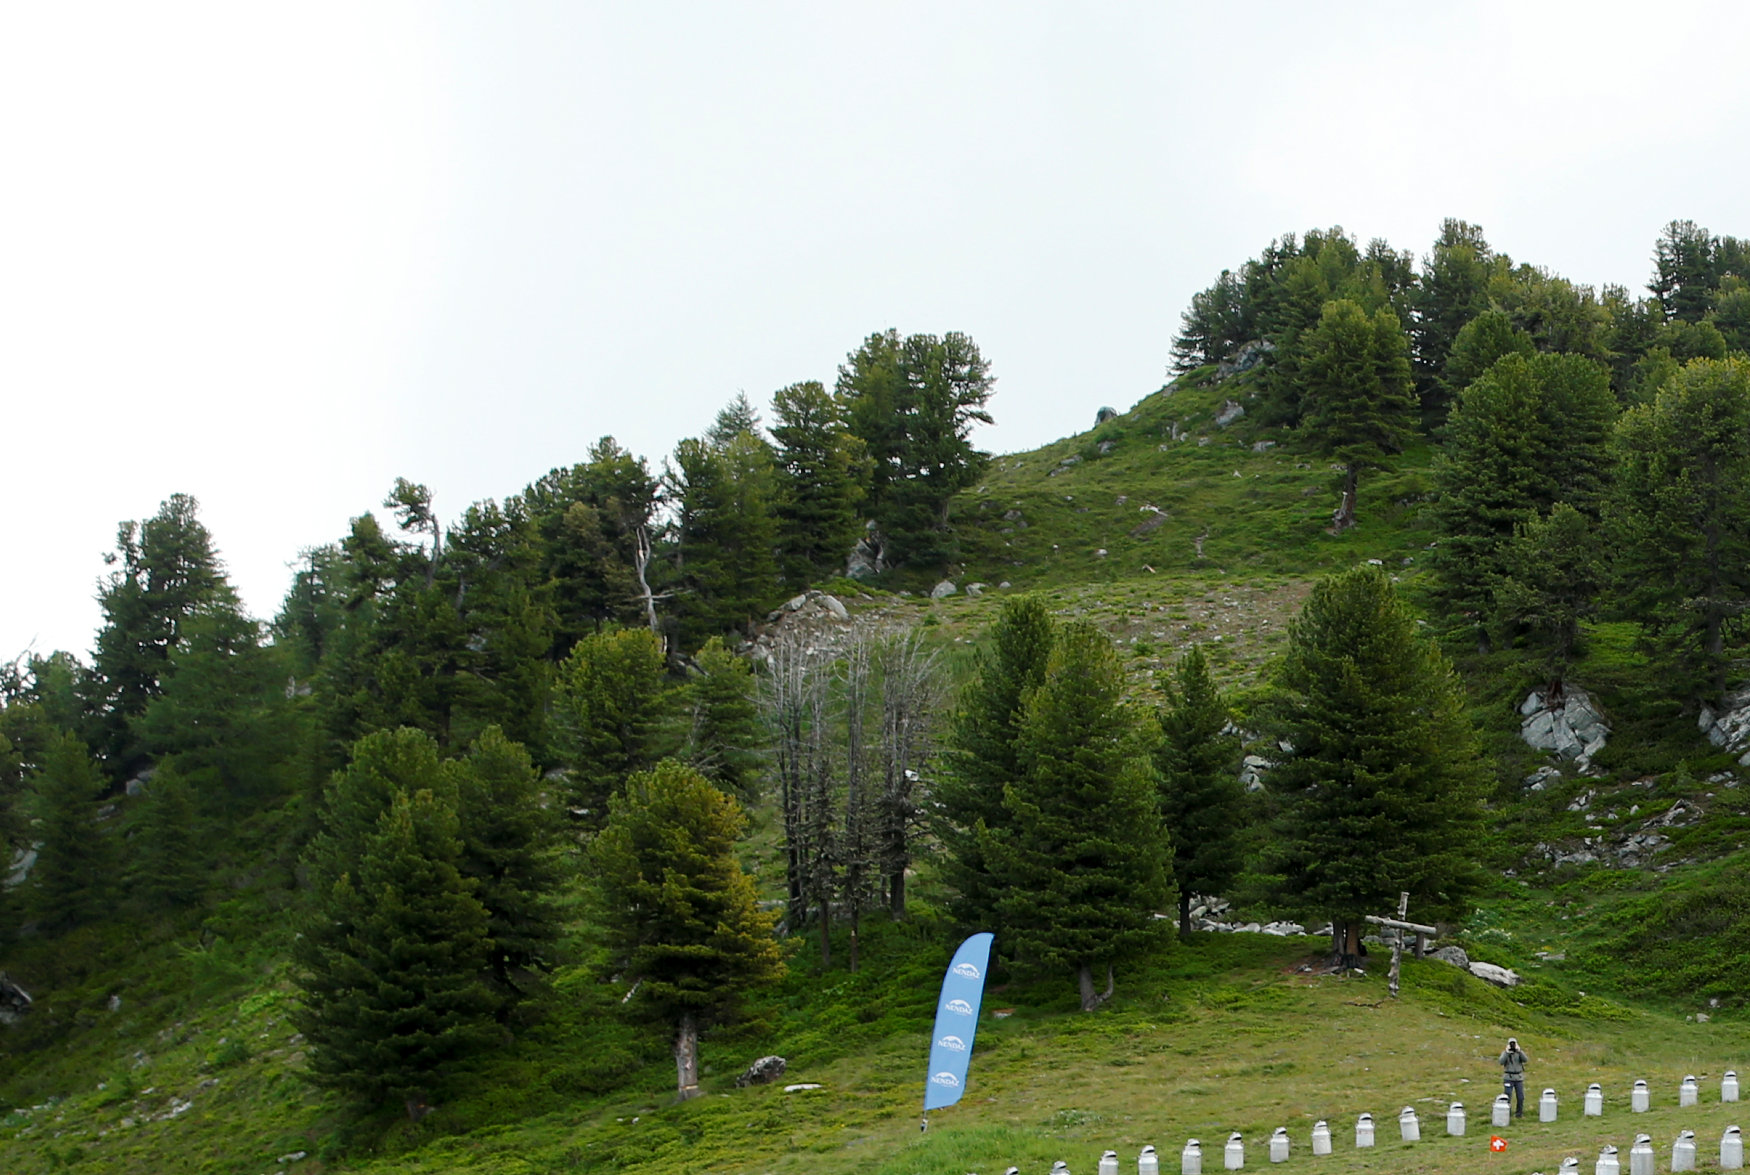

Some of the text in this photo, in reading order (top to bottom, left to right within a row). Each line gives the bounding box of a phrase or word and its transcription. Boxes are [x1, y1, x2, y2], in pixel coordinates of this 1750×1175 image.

[953, 967, 980, 979] NENDAZ
[945, 1003, 973, 1015] NENDAZ
[937, 1040, 966, 1051] NENDAZ
[931, 1076, 960, 1087] NENDAZ
